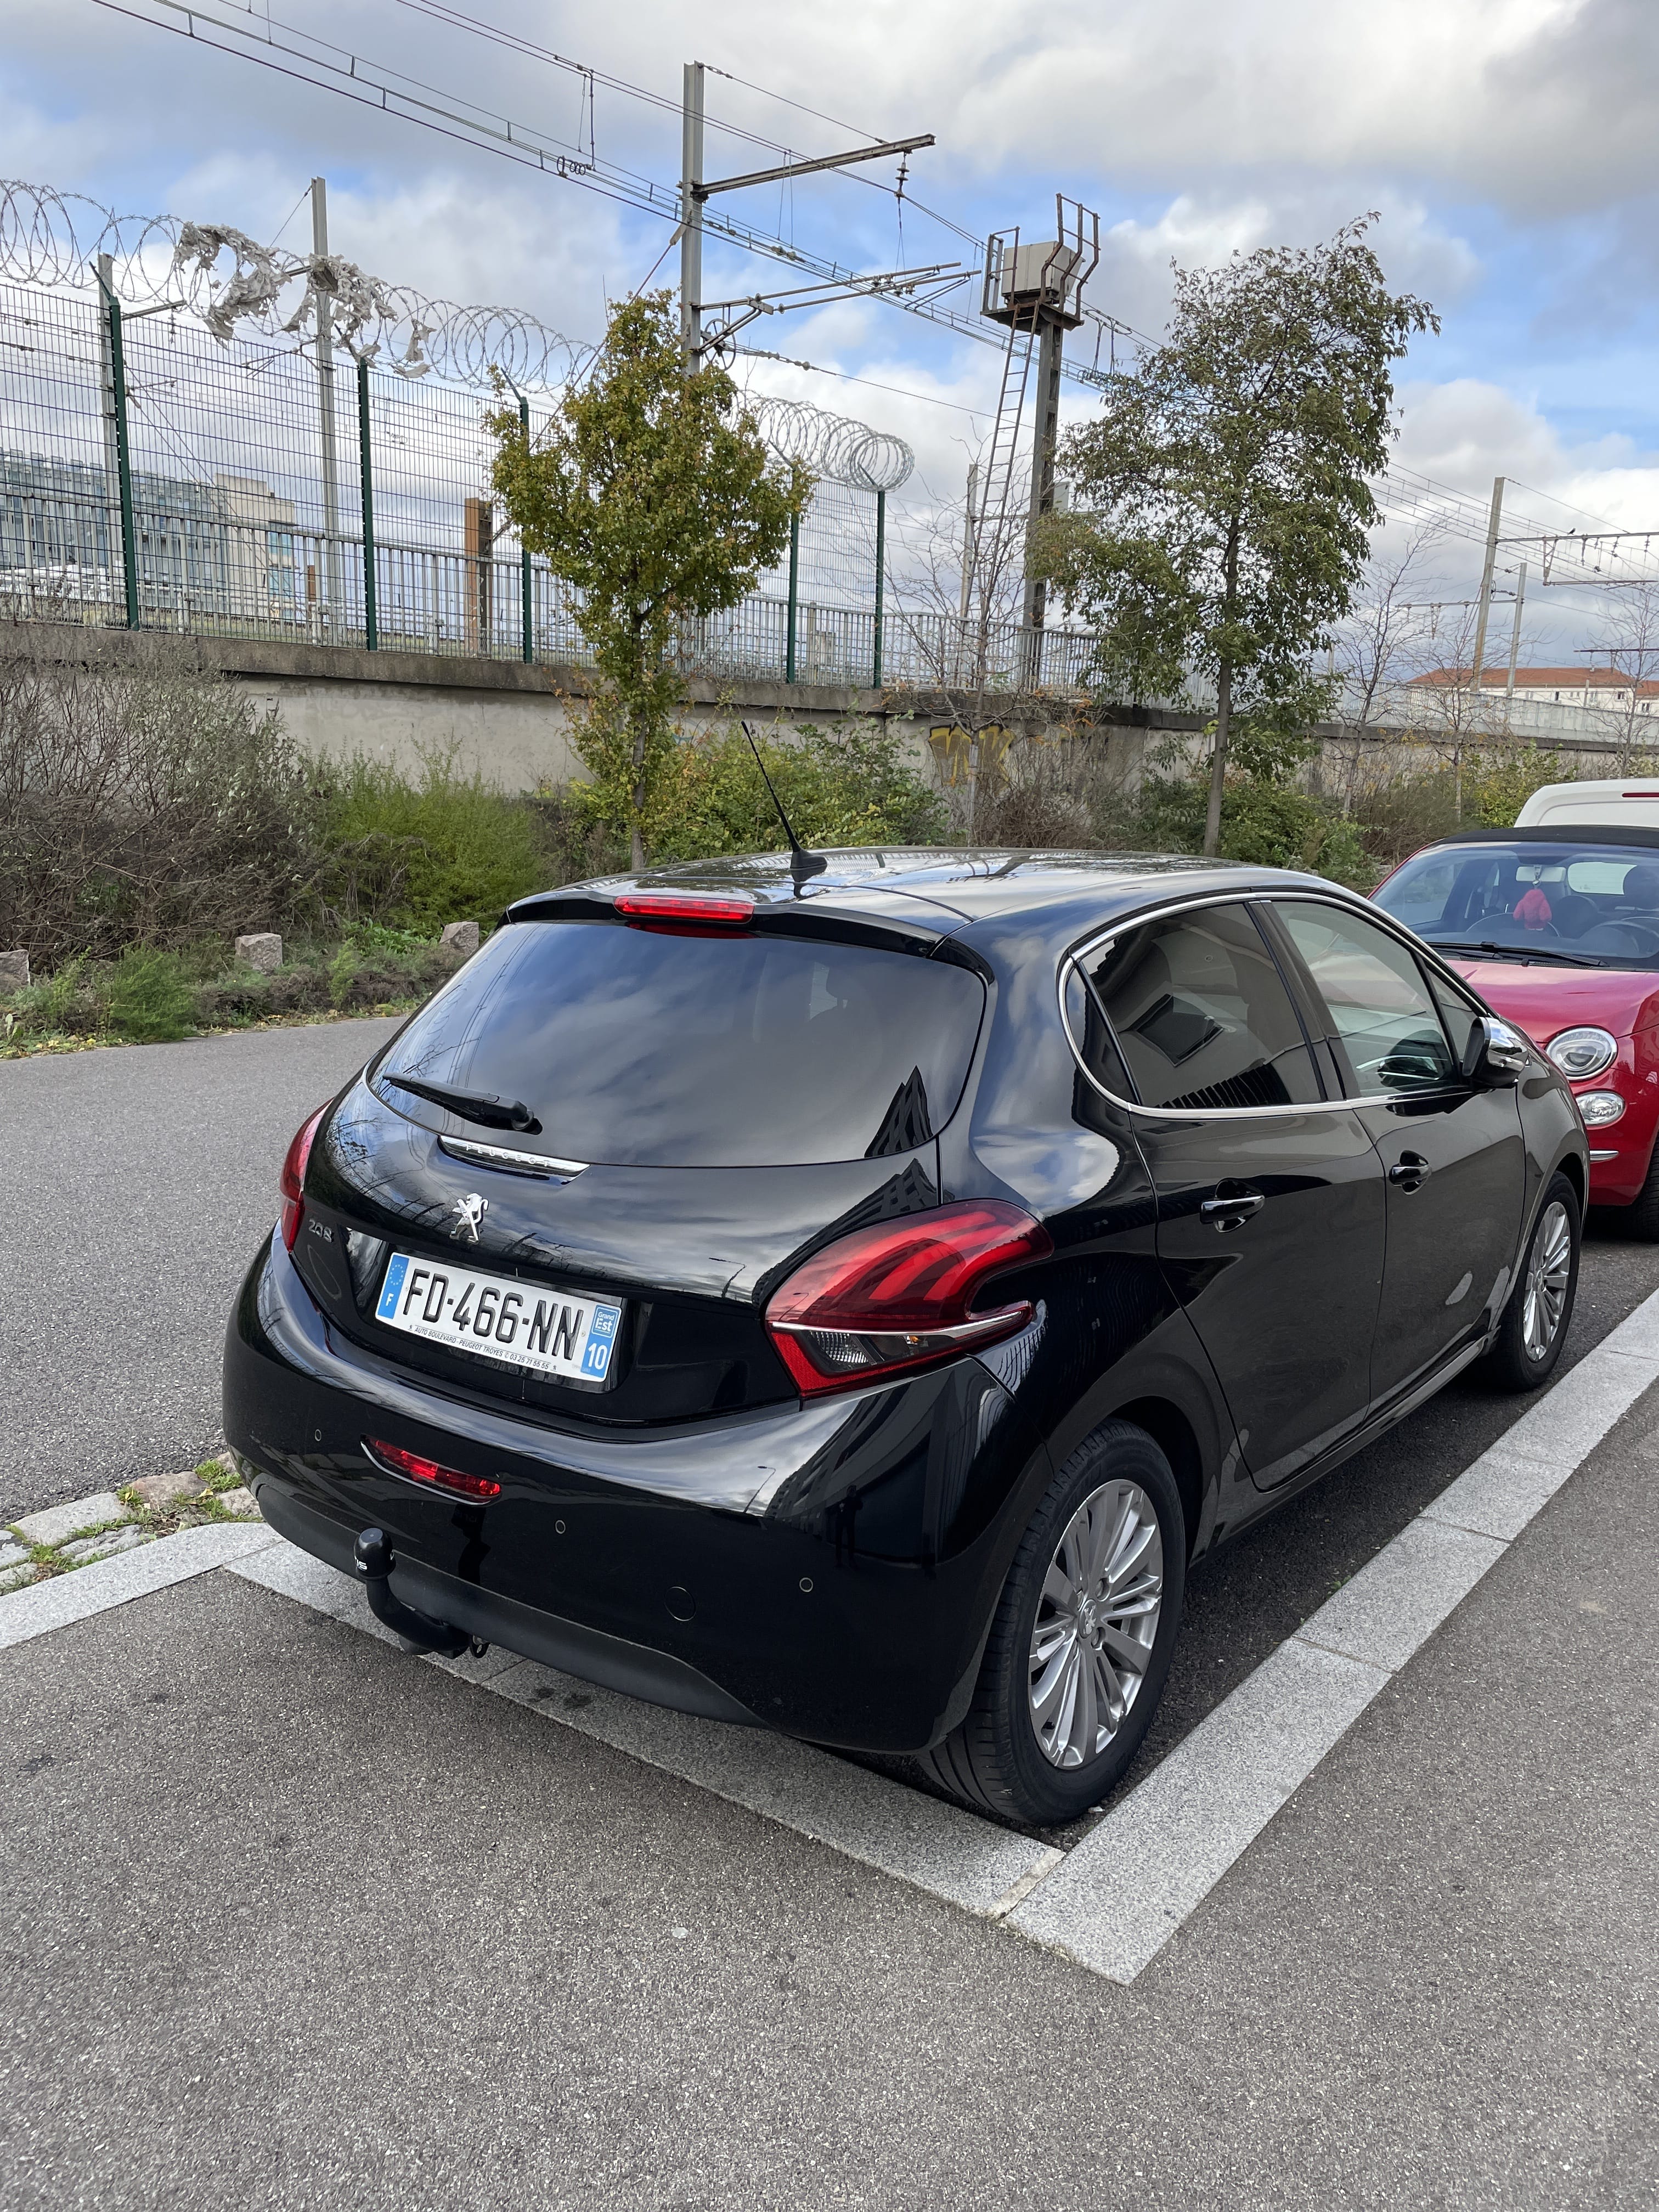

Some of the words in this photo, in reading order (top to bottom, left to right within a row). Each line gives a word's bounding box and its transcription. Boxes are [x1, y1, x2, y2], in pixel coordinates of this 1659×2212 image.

[466, 1144, 549, 1167] PEUGEOT
[308, 1218, 332, 1243] 208
[386, 1293, 394, 1306] F
[403, 1268, 584, 1361] FD-466-NN
[595, 1317, 613, 1332] Est
[597, 1311, 615, 1321] Grand
[414, 1327, 428, 1335] AUTO
[428, 1329, 456, 1344] BOULEVARD
[459, 1339, 483, 1351] PEUGEOT
[483, 1346, 504, 1357] TROYES
[588, 1343, 608, 1370] 10
